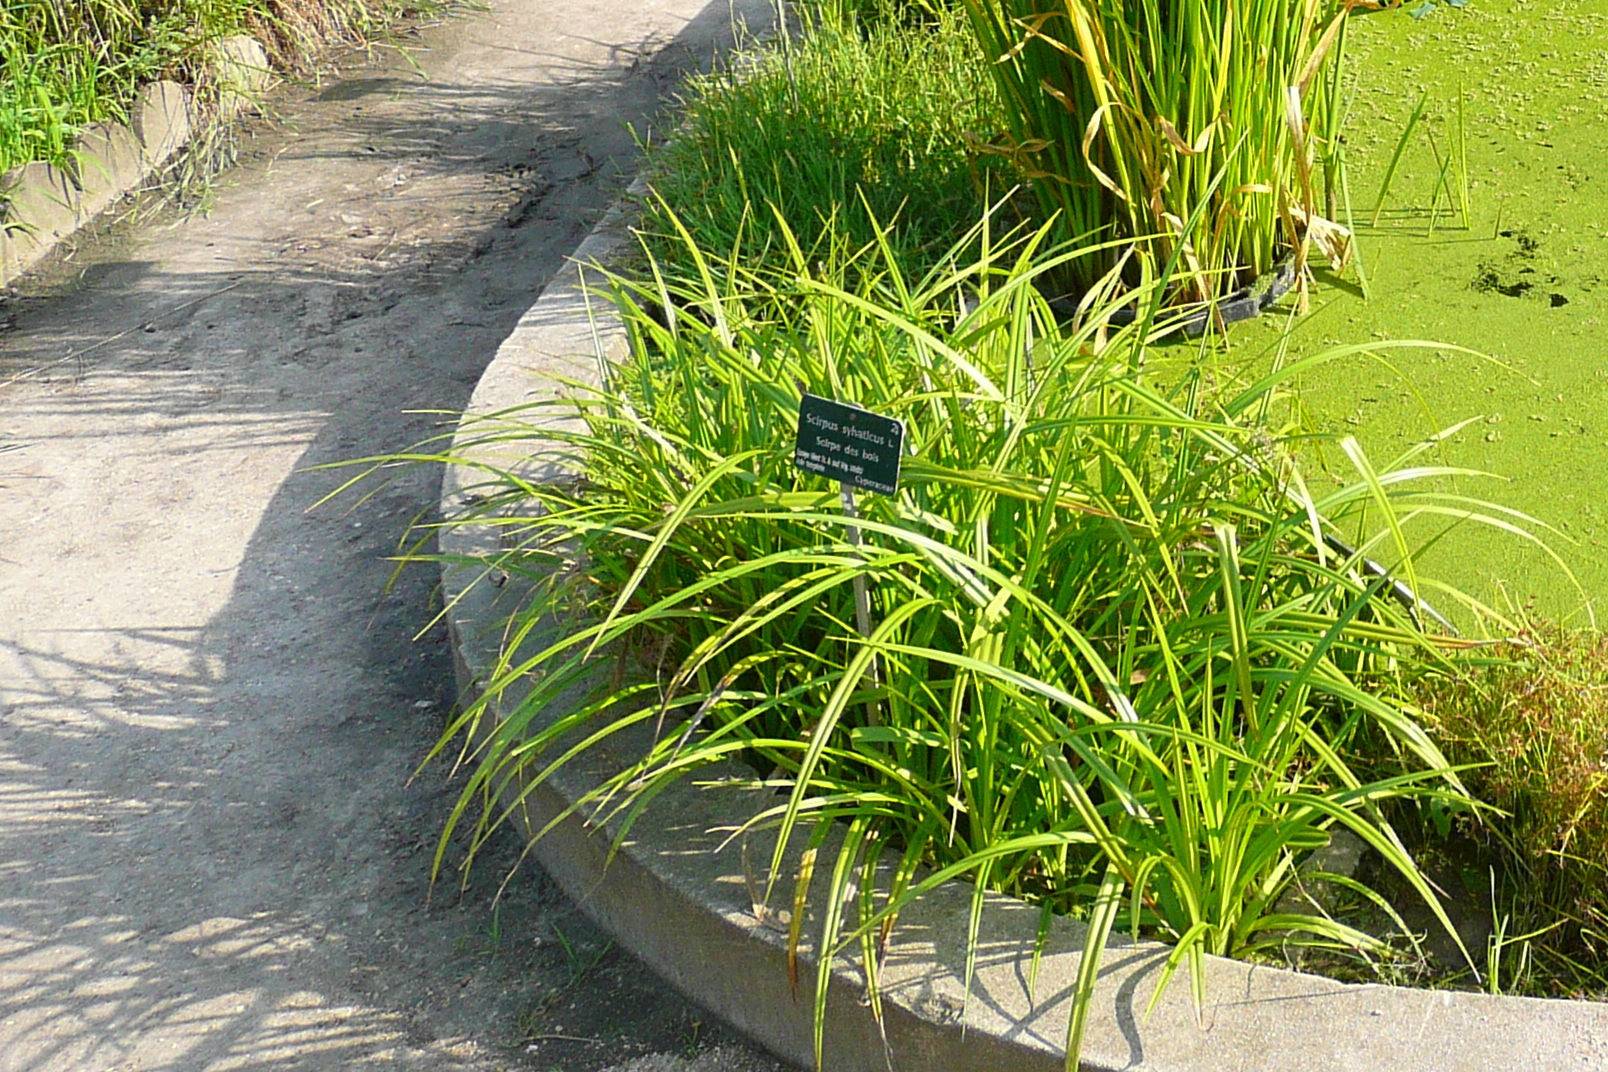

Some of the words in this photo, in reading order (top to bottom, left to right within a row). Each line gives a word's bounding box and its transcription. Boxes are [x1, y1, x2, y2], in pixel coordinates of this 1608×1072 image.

[806, 413, 838, 431] Scirpus
[842, 425, 884, 446] sylvaticus
[816, 436, 841, 451] Scirpe
[844, 445, 859, 457] des
[862, 449, 879, 463] bois
